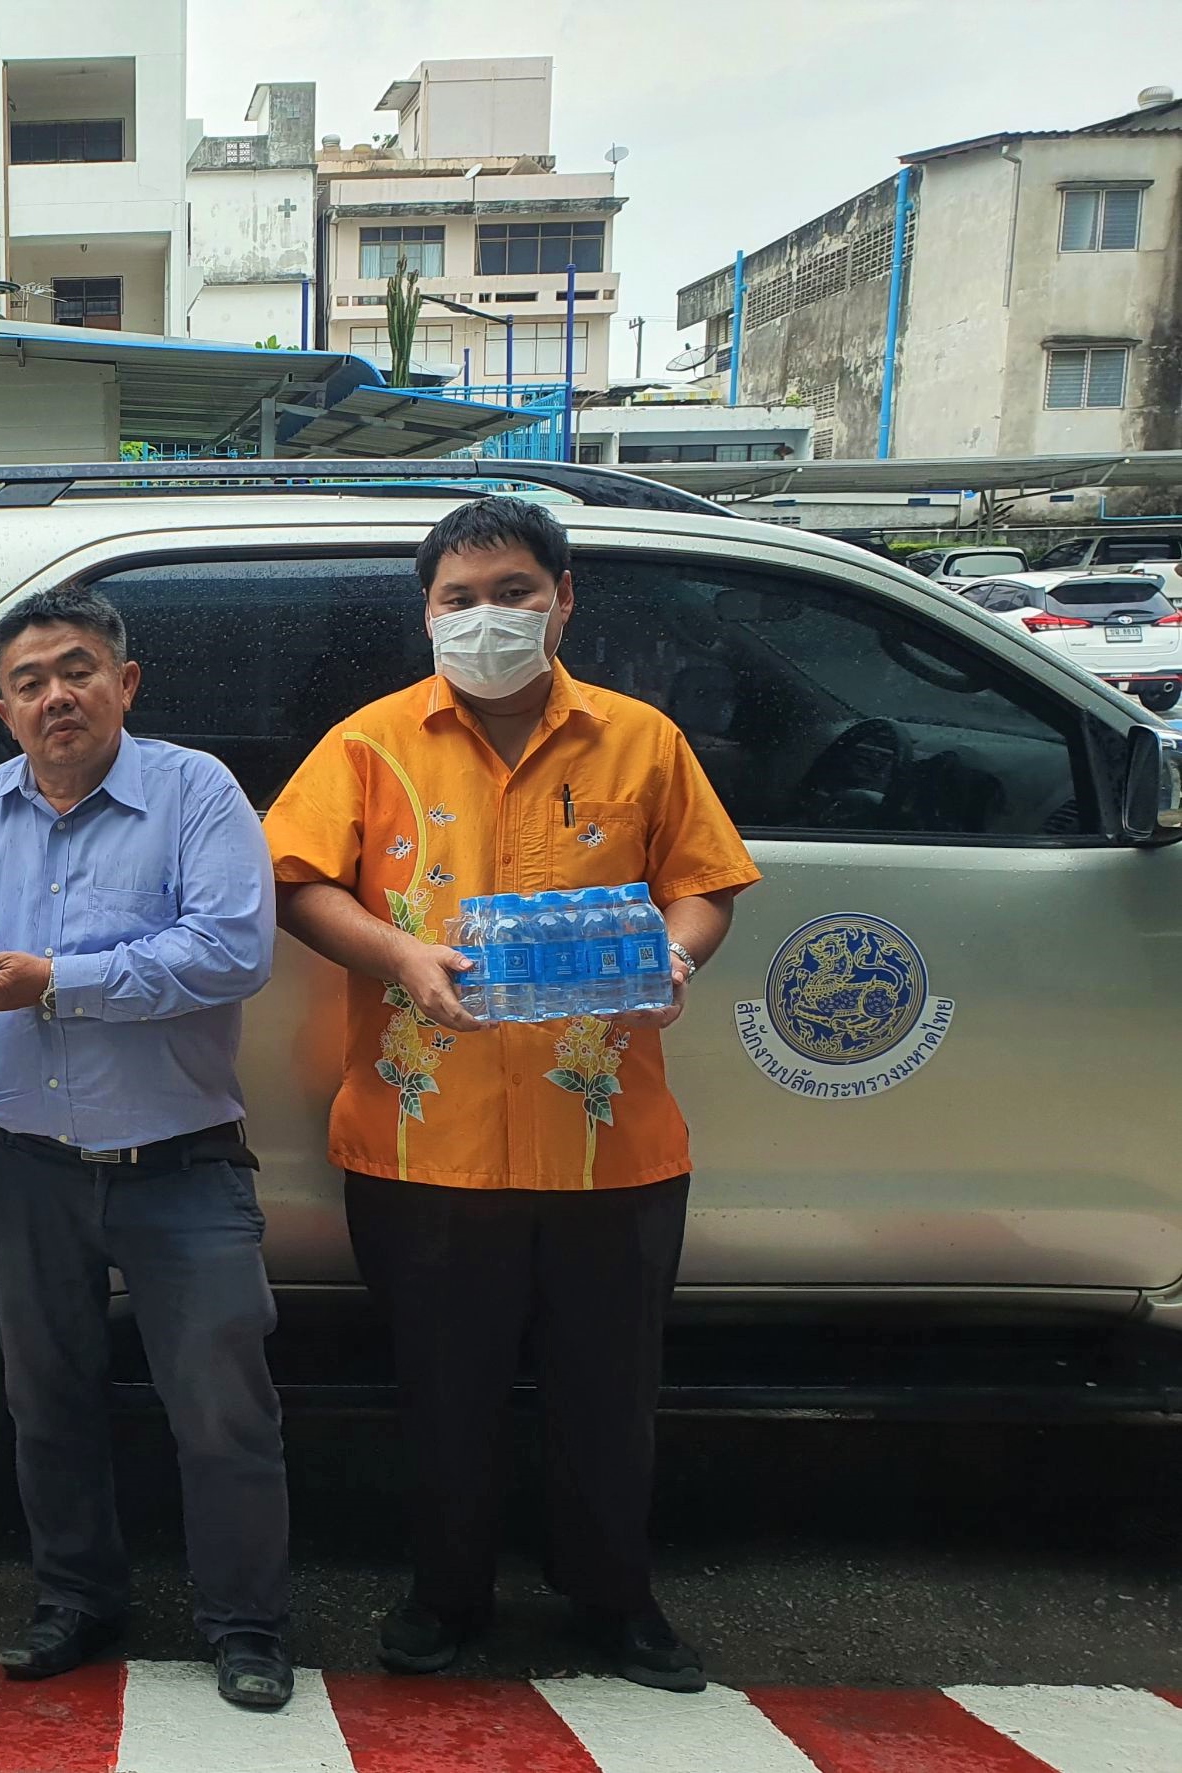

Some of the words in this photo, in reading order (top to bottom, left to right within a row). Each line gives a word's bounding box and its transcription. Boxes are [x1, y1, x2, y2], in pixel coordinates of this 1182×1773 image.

[737, 1000, 953, 1098] สำนักงานปลัดกระทรวงมหาดไทย
